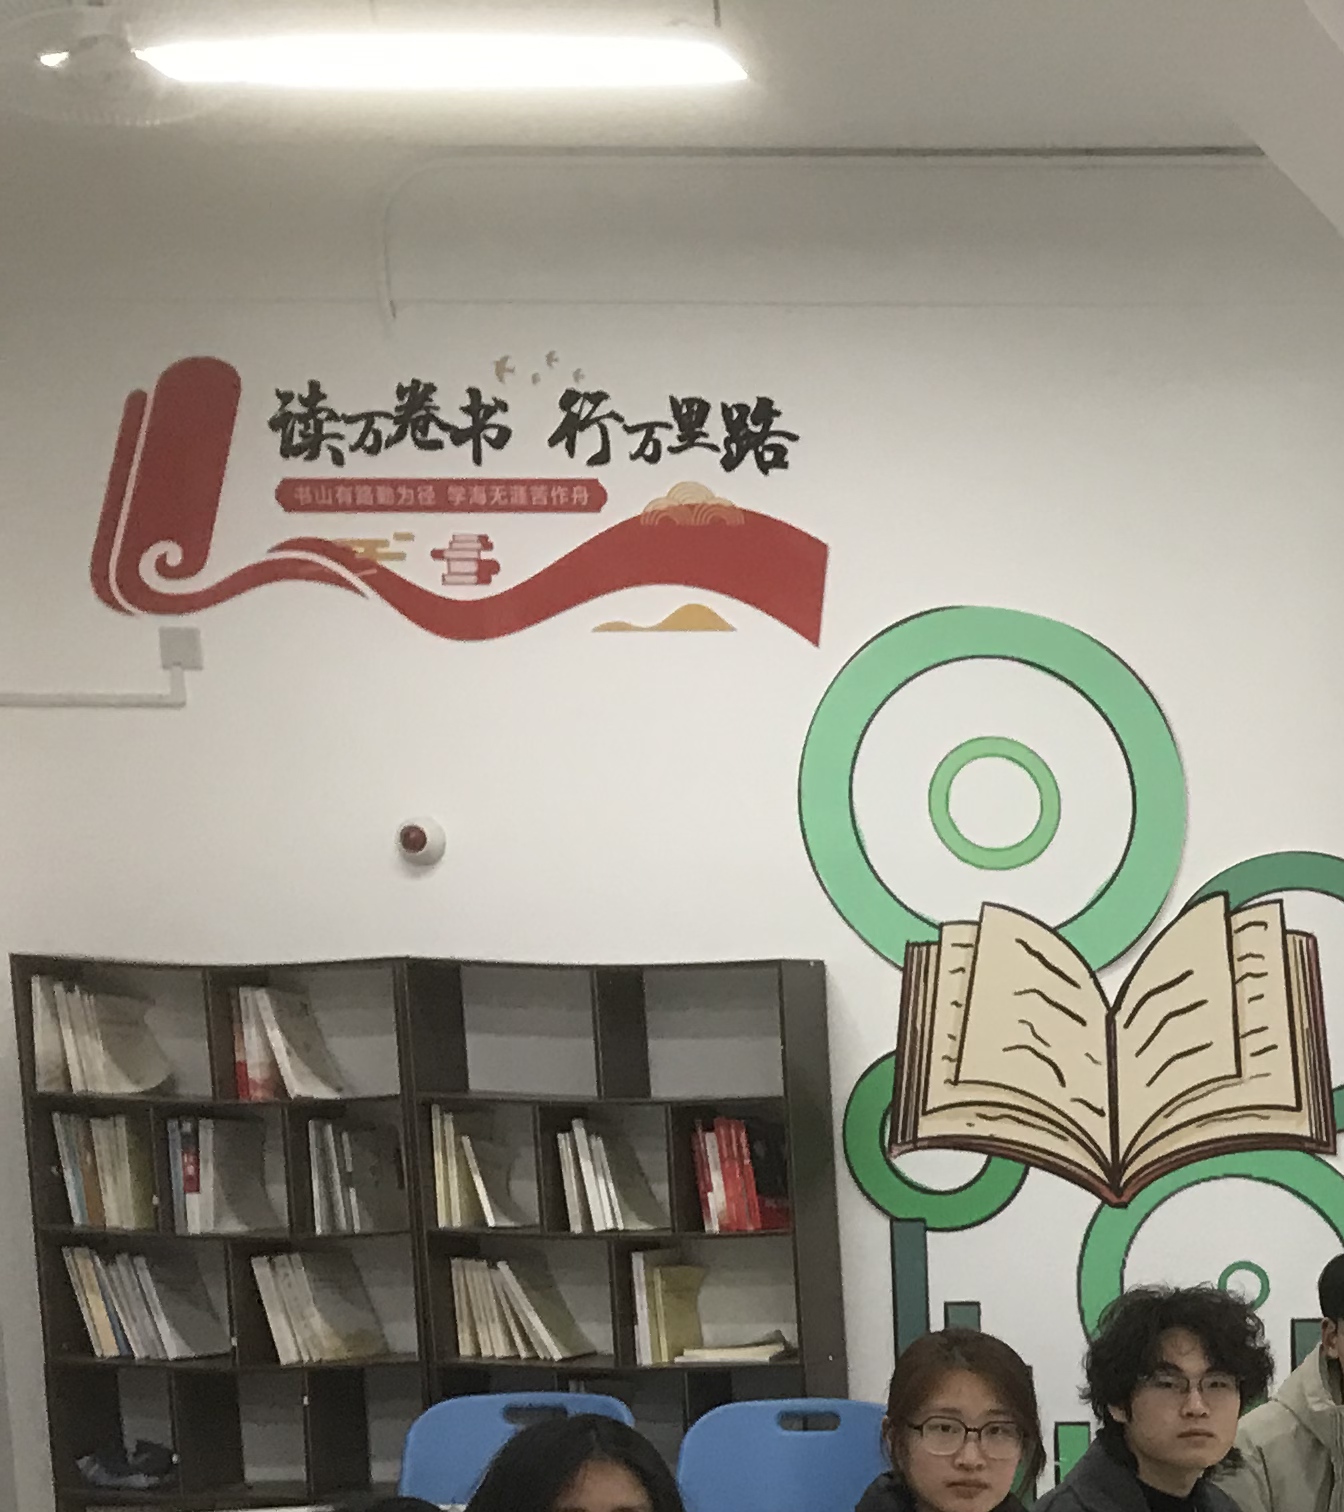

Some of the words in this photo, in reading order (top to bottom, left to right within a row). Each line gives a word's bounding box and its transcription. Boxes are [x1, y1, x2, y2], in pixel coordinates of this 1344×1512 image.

[269, 378, 512, 467] 读万卷书
[548, 387, 800, 475] 行万里路
